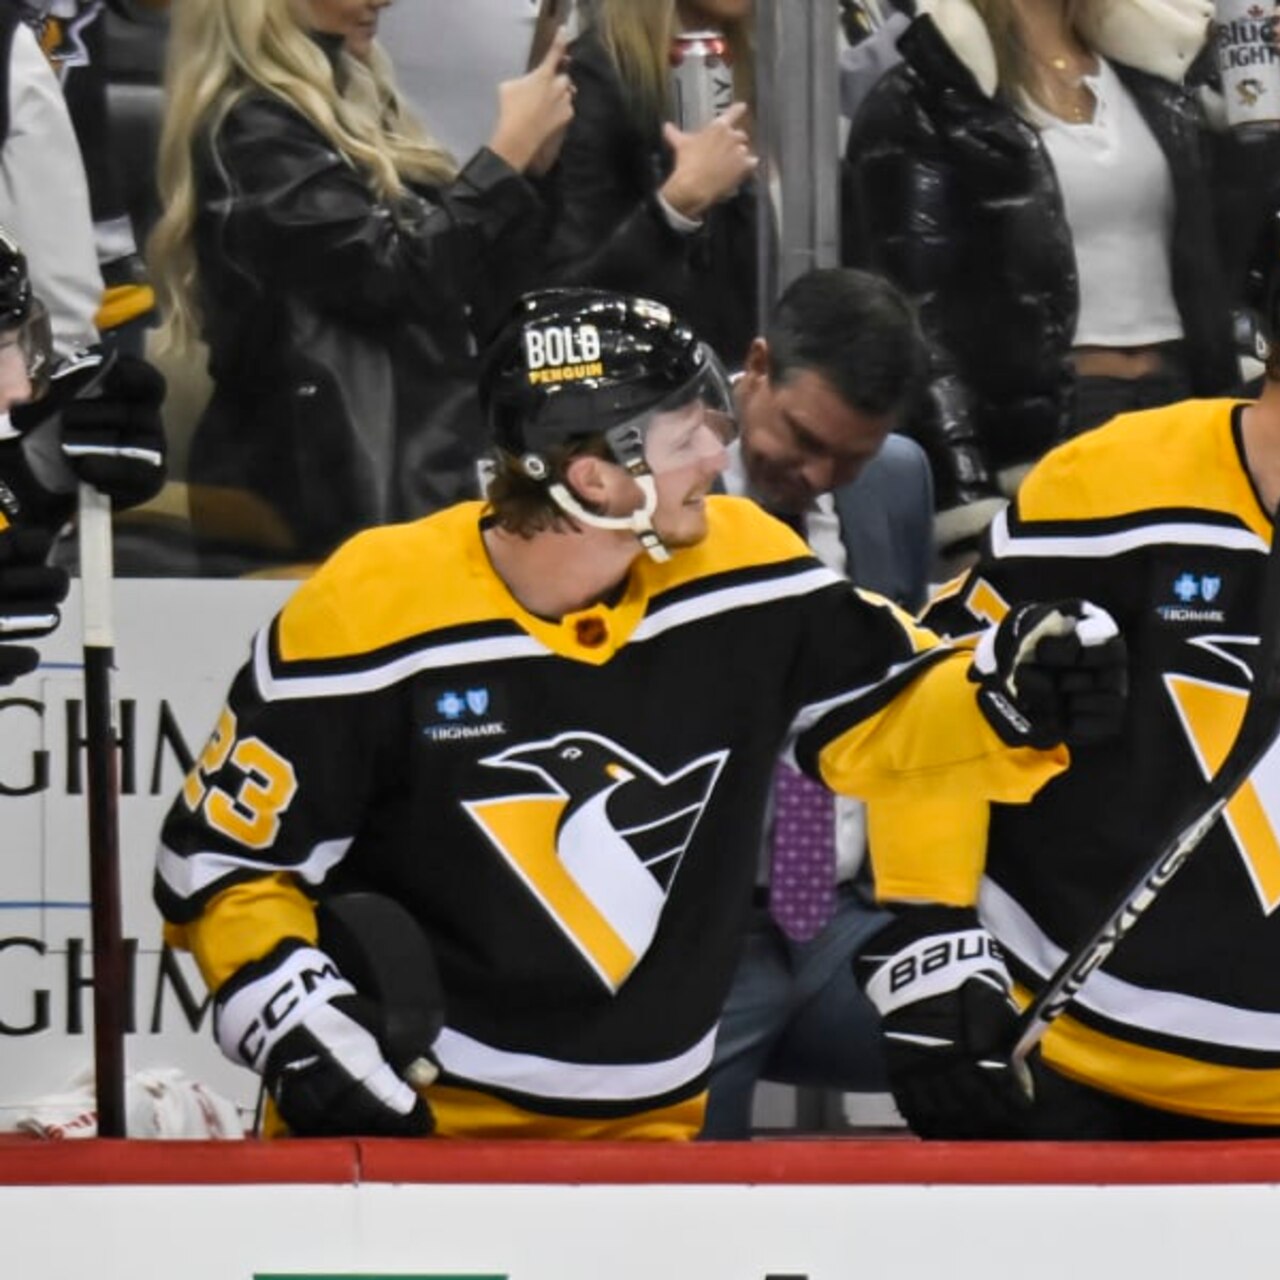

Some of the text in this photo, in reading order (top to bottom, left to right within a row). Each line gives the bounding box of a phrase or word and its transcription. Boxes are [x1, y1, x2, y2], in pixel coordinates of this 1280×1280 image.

[525, 325, 601, 369] BOLD
[528, 361, 603, 385] PENGUIN
[238, 962, 343, 1068] CCM
